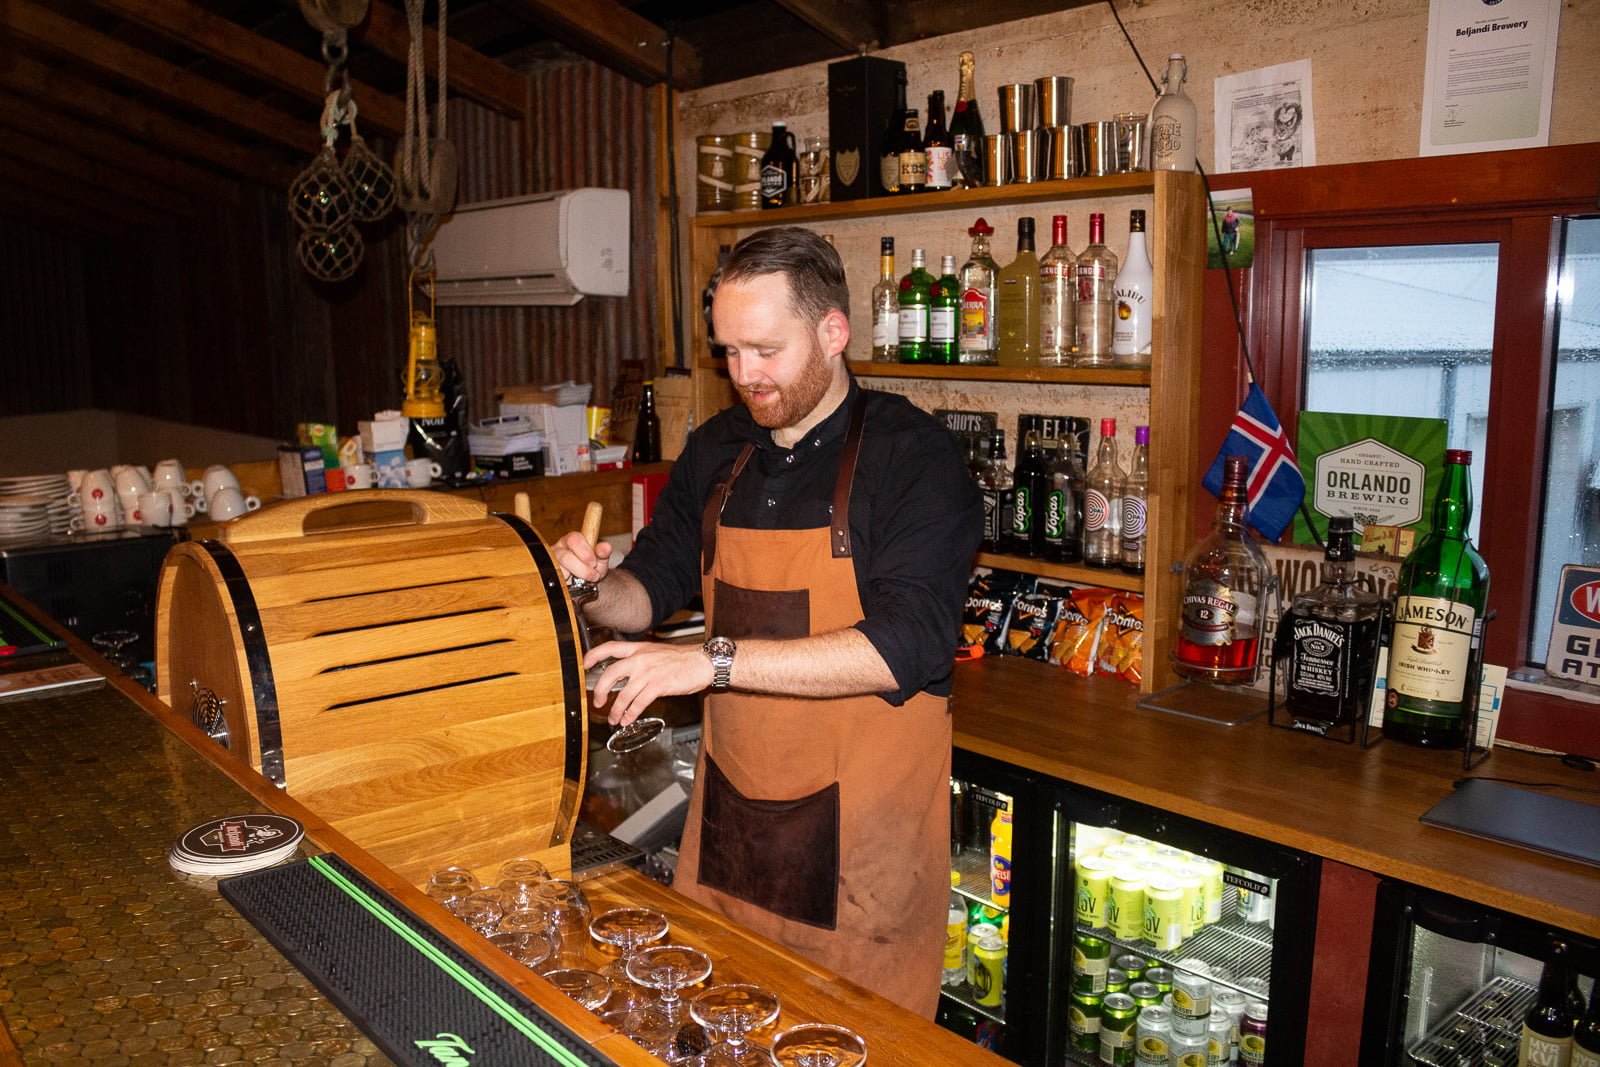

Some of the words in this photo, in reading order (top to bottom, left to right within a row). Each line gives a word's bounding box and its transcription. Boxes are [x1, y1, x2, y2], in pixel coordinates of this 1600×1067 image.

[1456, 24, 1490, 37] Beljandi
[1492, 20, 1529, 32] Brewery
[902, 164, 925, 174] KBS
[946, 414, 982, 432] SHOTS
[1340, 457, 1362, 465] HAND
[1364, 460, 1401, 468] CRAFTED
[1327, 470, 1411, 495] ORLANDO
[1327, 490, 1410, 506] BREWING
[1045, 495, 1060, 536] Topas
[965, 597, 1003, 612] Doritos
[1207, 597, 1234, 612] REGAL
[1200, 609, 1209, 619] 12
[1398, 605, 1467, 629] JAMESON
[1294, 625, 1313, 640] JACK
[1313, 623, 1345, 648] DANIEL'S
[1300, 664, 1333, 676] WHISKEY
[1225, 874, 1260, 891] TEFCOLD
